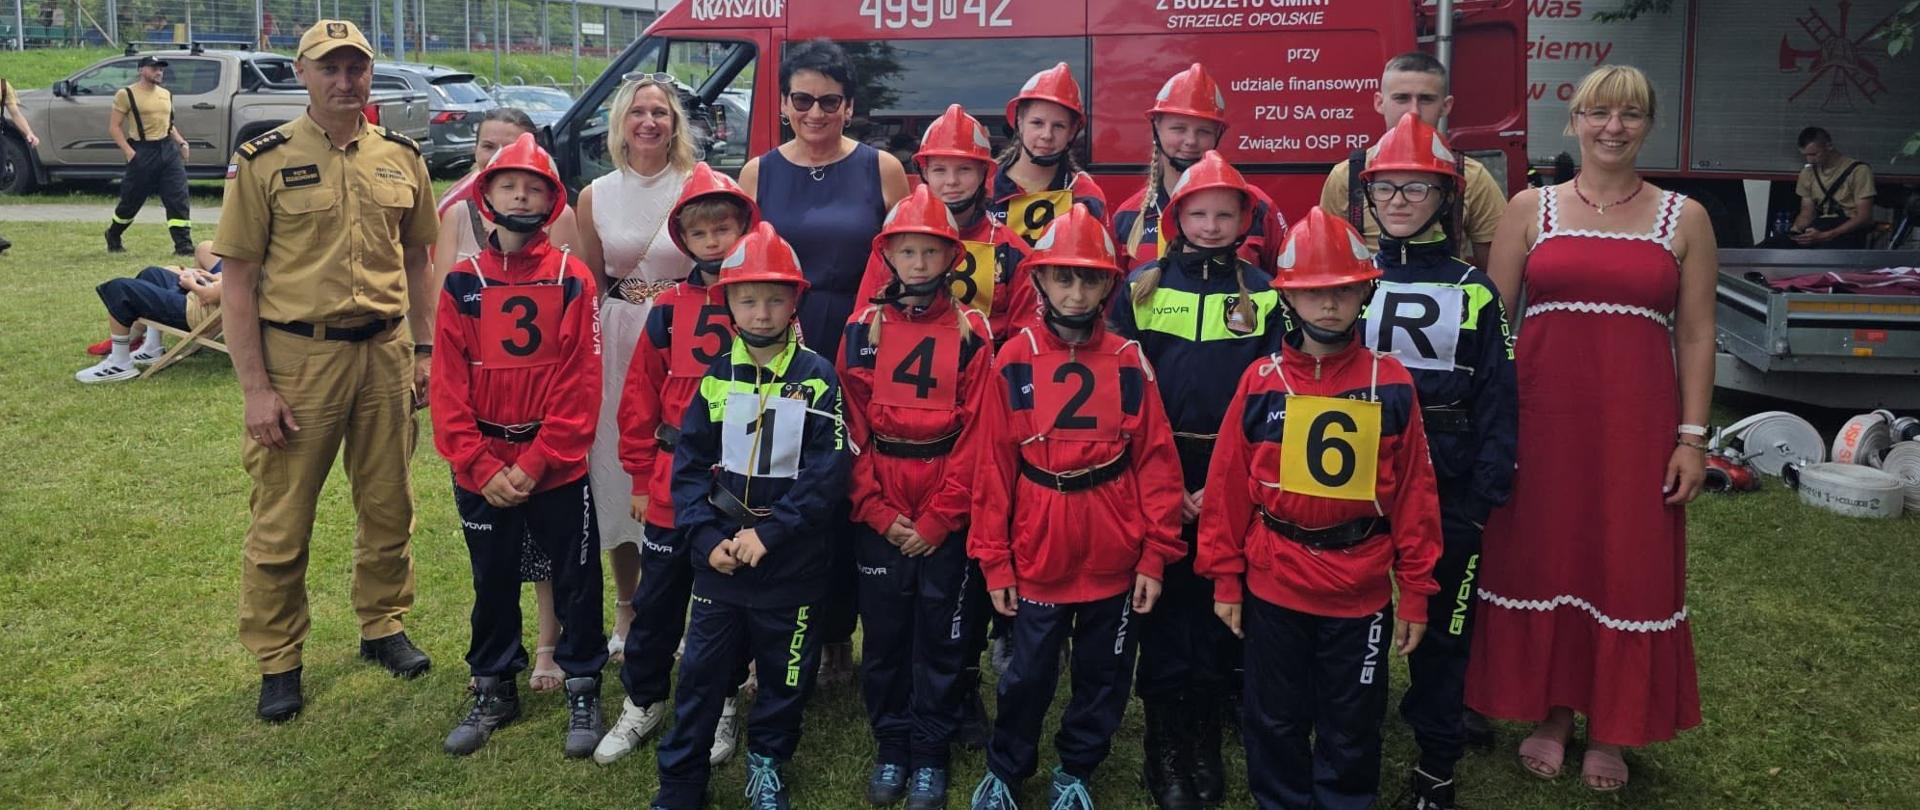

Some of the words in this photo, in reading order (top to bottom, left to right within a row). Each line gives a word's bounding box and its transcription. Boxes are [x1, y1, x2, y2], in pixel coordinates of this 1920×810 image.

[1166, 13, 1244, 28] STRZELCE
[1248, 11, 1325, 26] OPOLSKIE
[1287, 48, 1320, 62] przy
[1527, 35, 1613, 67] ziemy
[1231, 78, 1285, 92] udziale
[1289, 76, 1379, 93] finansowym
[1255, 107, 1289, 120] PZU
[1293, 106, 1316, 119] SA
[1320, 107, 1354, 120] oraz
[1238, 135, 1301, 152] Związku
[1305, 135, 1341, 149] OSP
[1346, 134, 1370, 149] RP
[501, 296, 542, 356] 3
[691, 305, 732, 366] 5
[1152, 306, 1189, 315] IVOVA
[1377, 291, 1441, 359] R
[892, 336, 937, 399] 4
[1053, 363, 1097, 429] 2
[746, 409, 776, 475] 1
[1306, 410, 1358, 488] 6
[1449, 554, 1479, 635] GIVOVA
[785, 606, 810, 687] GIVOVA
[1360, 612, 1384, 684] GIVOV
